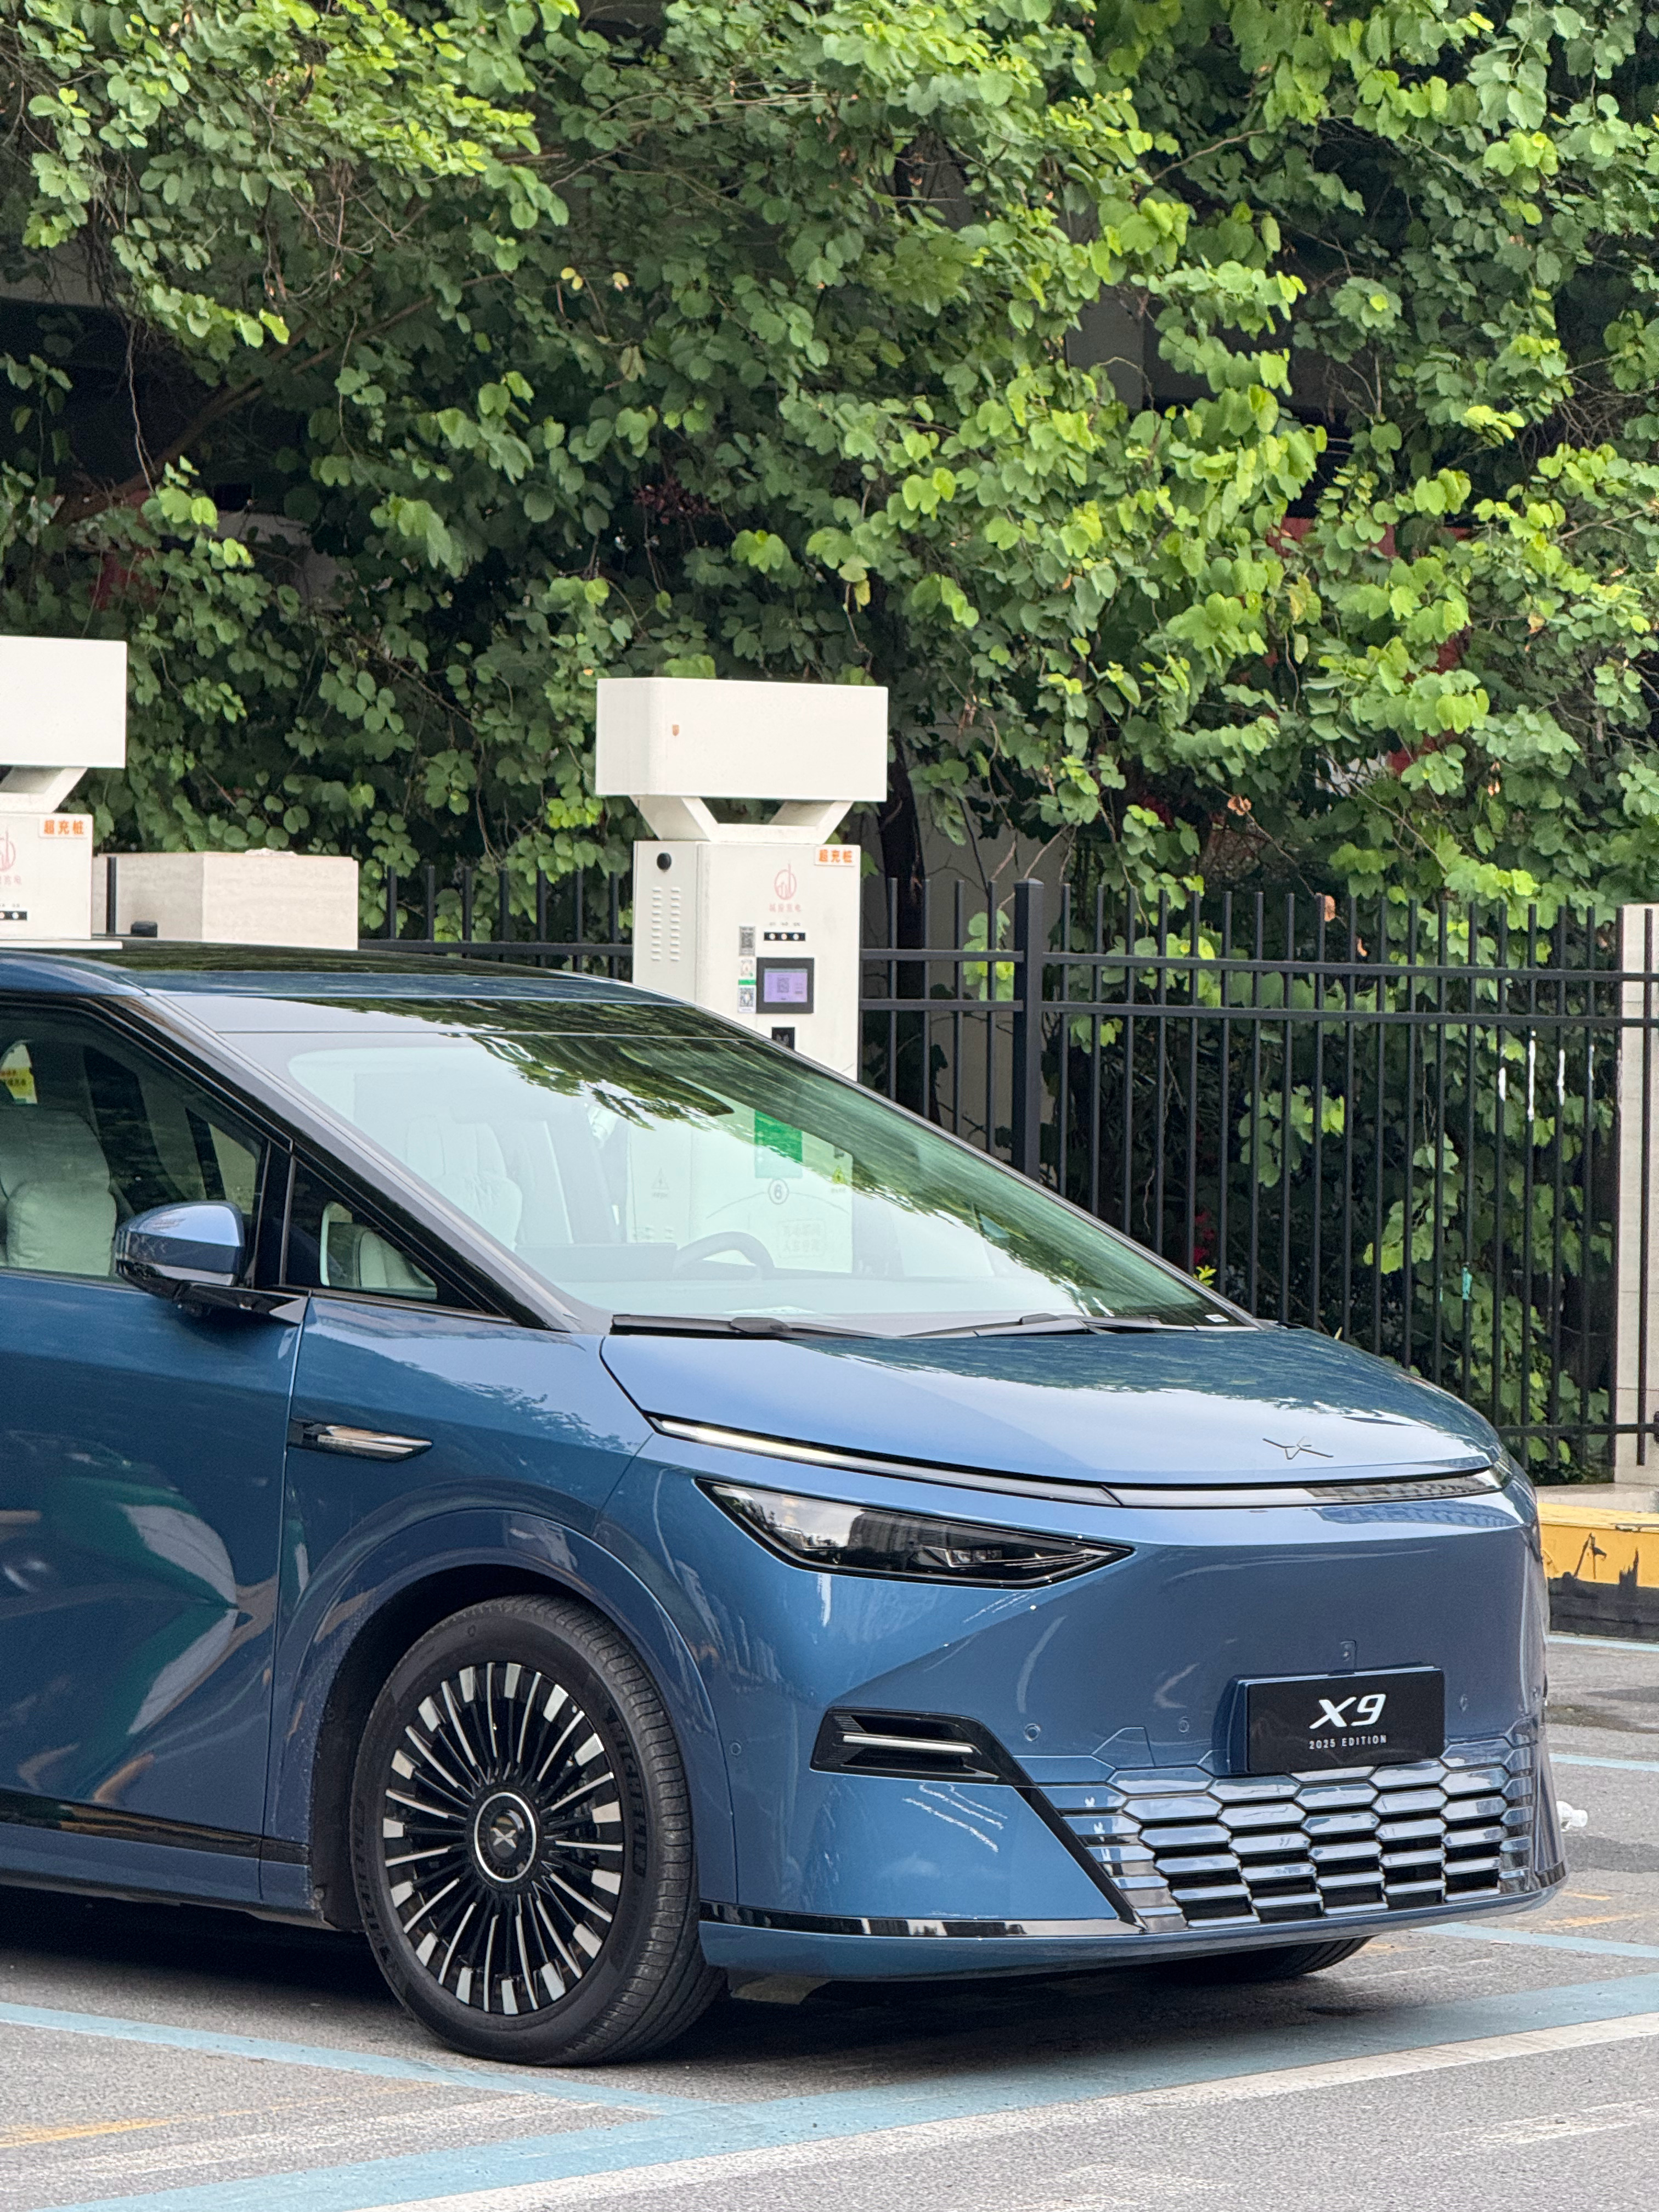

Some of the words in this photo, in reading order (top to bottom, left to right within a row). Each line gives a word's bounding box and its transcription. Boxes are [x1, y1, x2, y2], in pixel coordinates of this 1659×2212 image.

[44, 820, 83, 834] 超充桩
[819, 849, 853, 863] 超充桩
[1309, 1694, 1386, 1729] X9
[1308, 1739, 1336, 1750] 2025
[1342, 1735, 1386, 1747] EDITION
